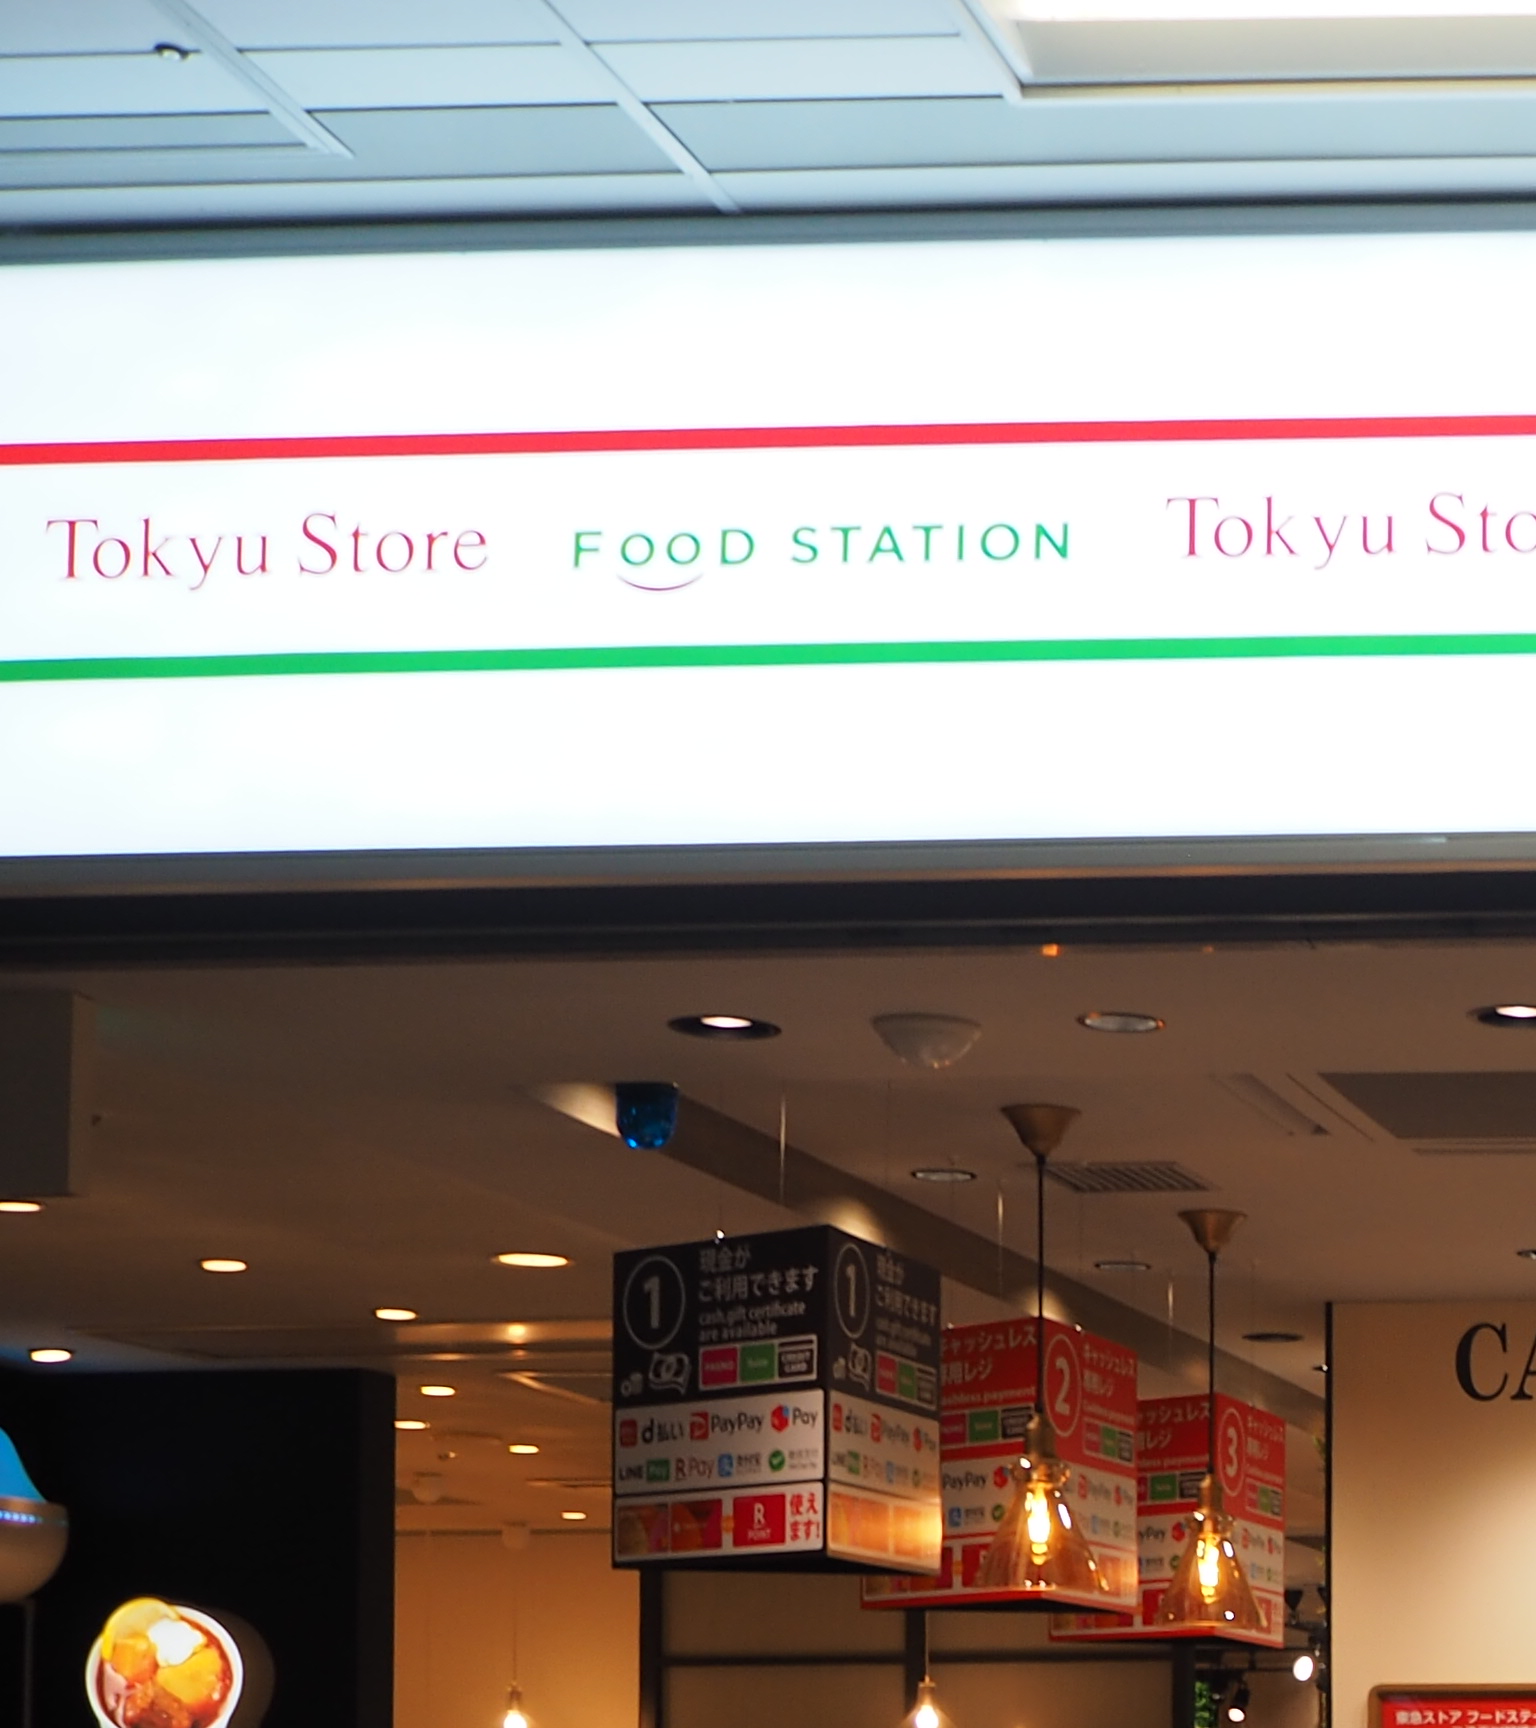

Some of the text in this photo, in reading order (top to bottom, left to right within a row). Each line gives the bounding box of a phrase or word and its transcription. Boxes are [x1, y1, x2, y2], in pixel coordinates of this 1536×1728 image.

[46, 508, 489, 590] Tokyu Store
[574, 520, 1073, 570] FOOD STATION
[1165, 493, 1398, 569] Tokyu
[700, 1265, 818, 1302] ご利用できます
[1055, 1356, 1070, 1415] 2
[711, 1411, 764, 1434] PayPay
[1225, 1427, 1239, 1479] 3
[790, 1492, 817, 1516] 使え
